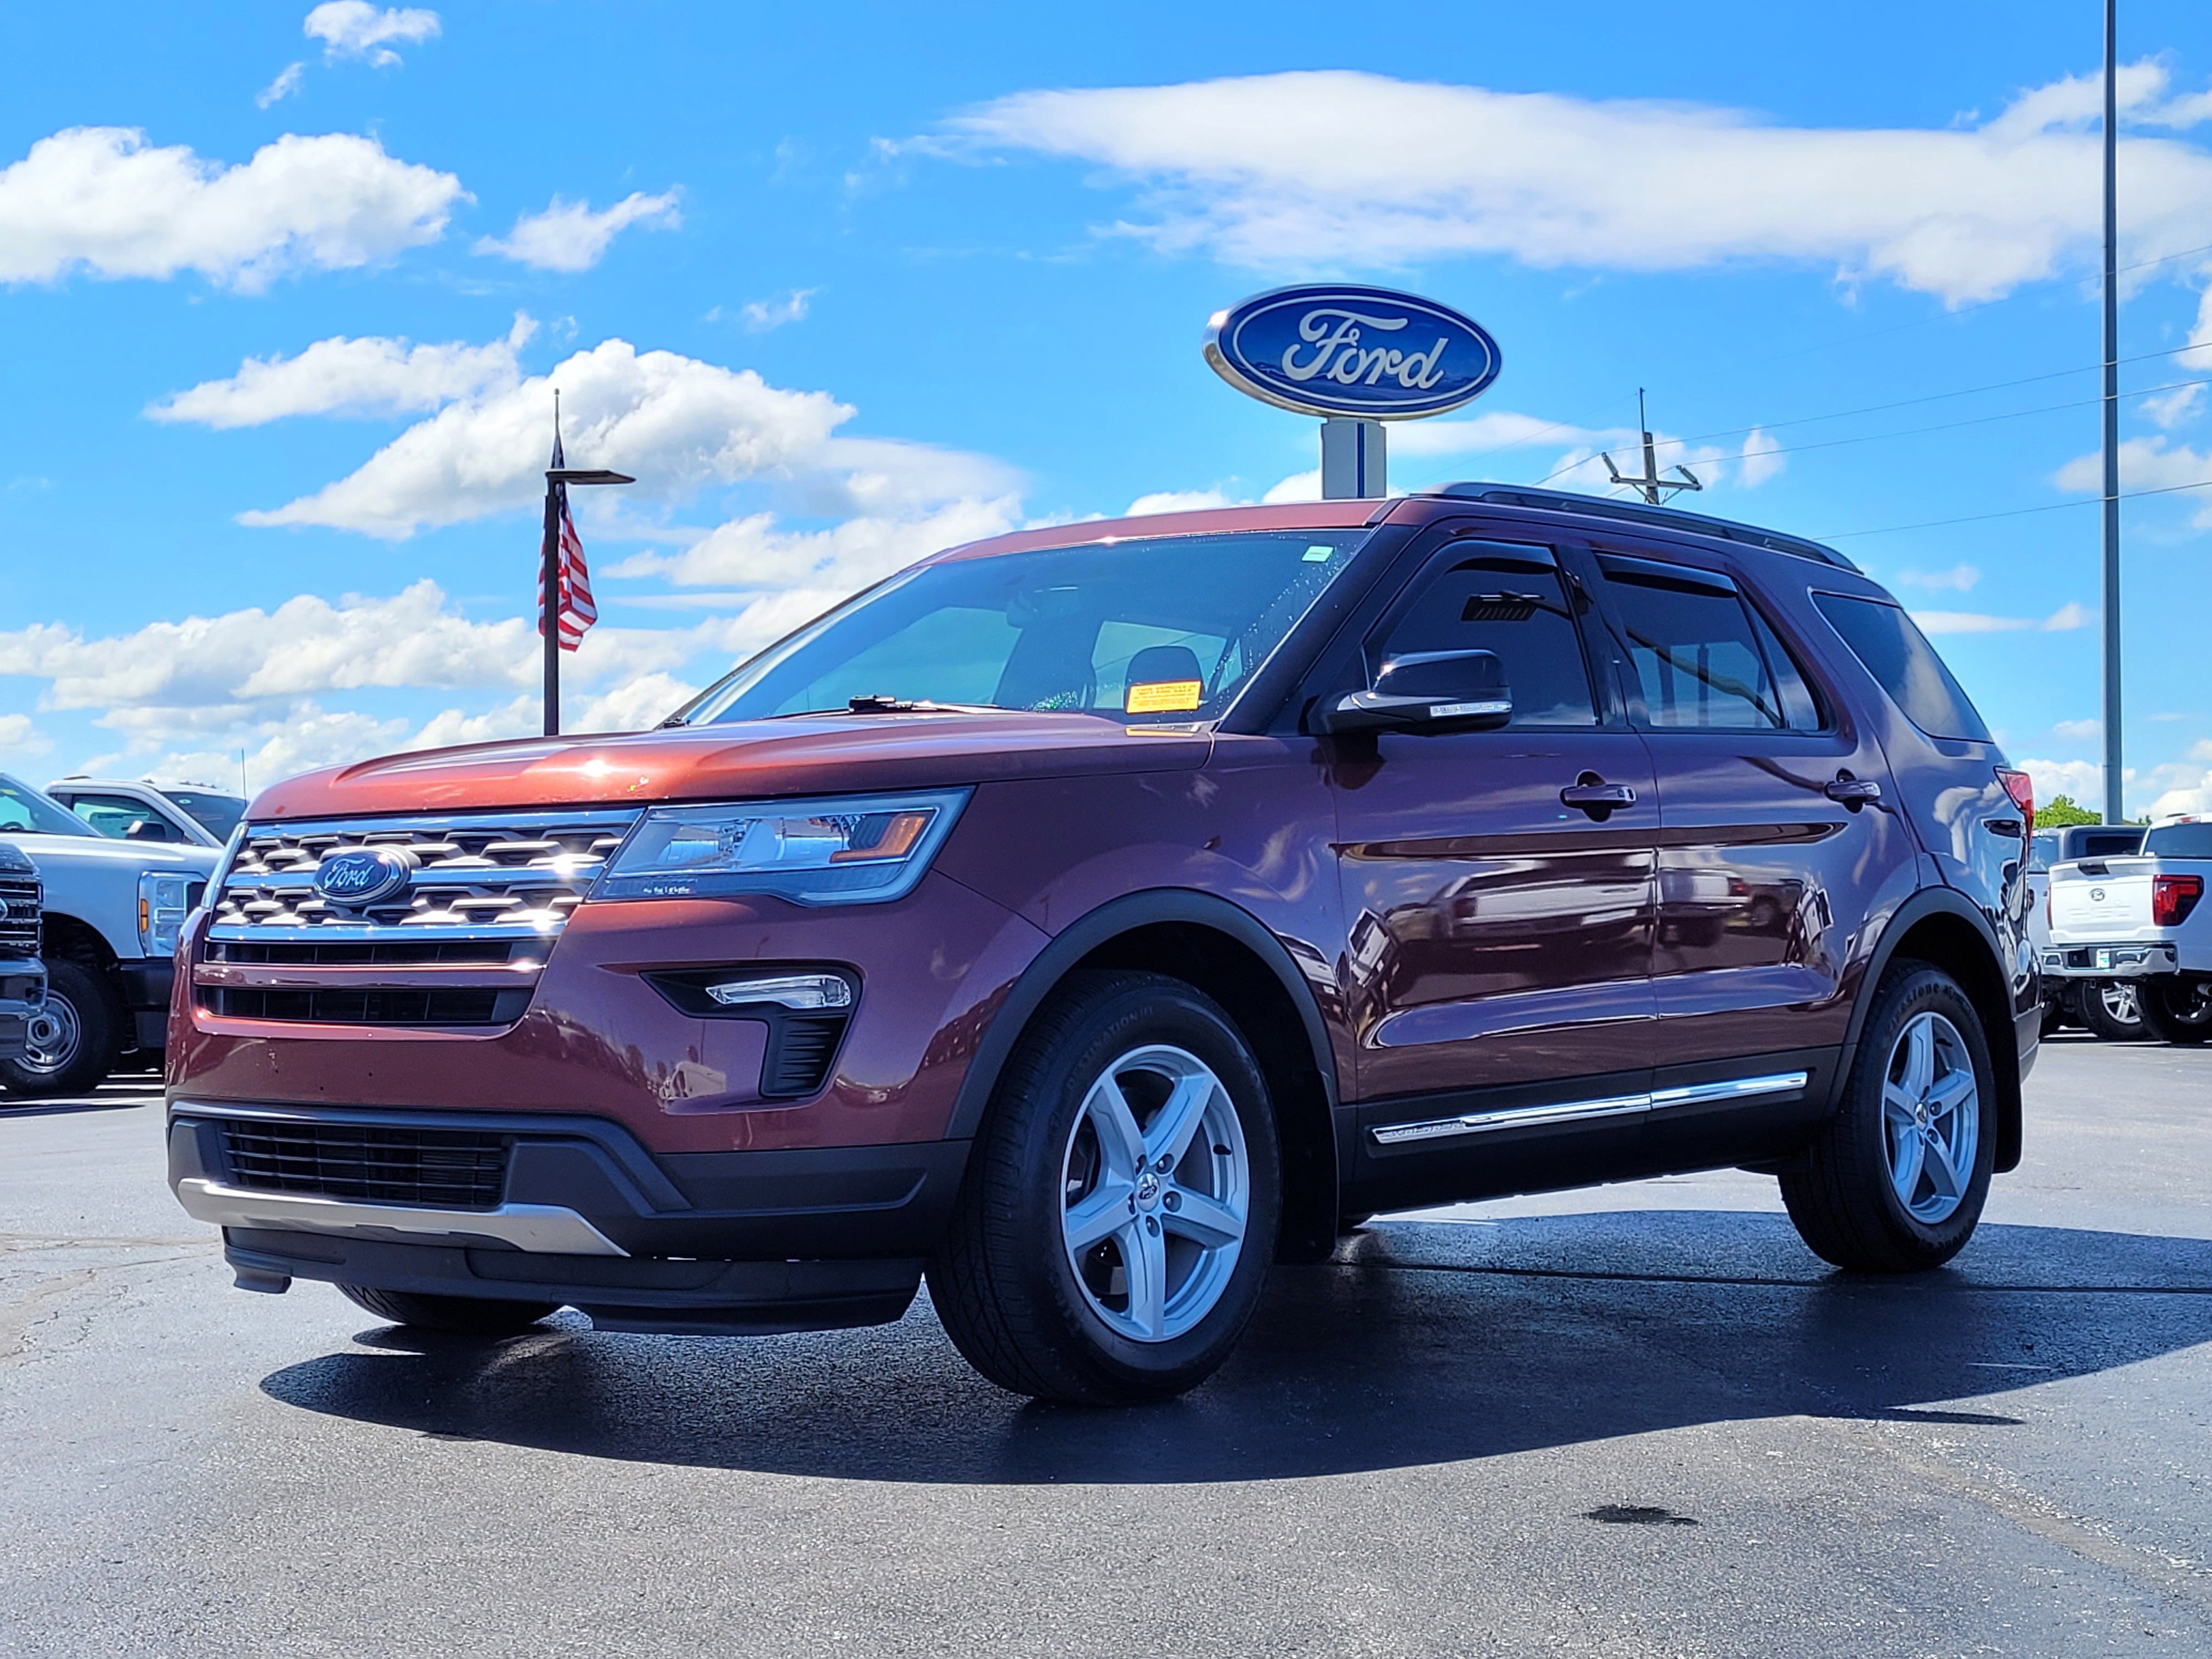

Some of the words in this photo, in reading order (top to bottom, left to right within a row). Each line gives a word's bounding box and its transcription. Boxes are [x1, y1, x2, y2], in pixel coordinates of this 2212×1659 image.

[1282, 309, 1449, 389] Ford
[324, 858, 374, 889] Ford
[1380, 1122, 1466, 1139] EXPLORER
